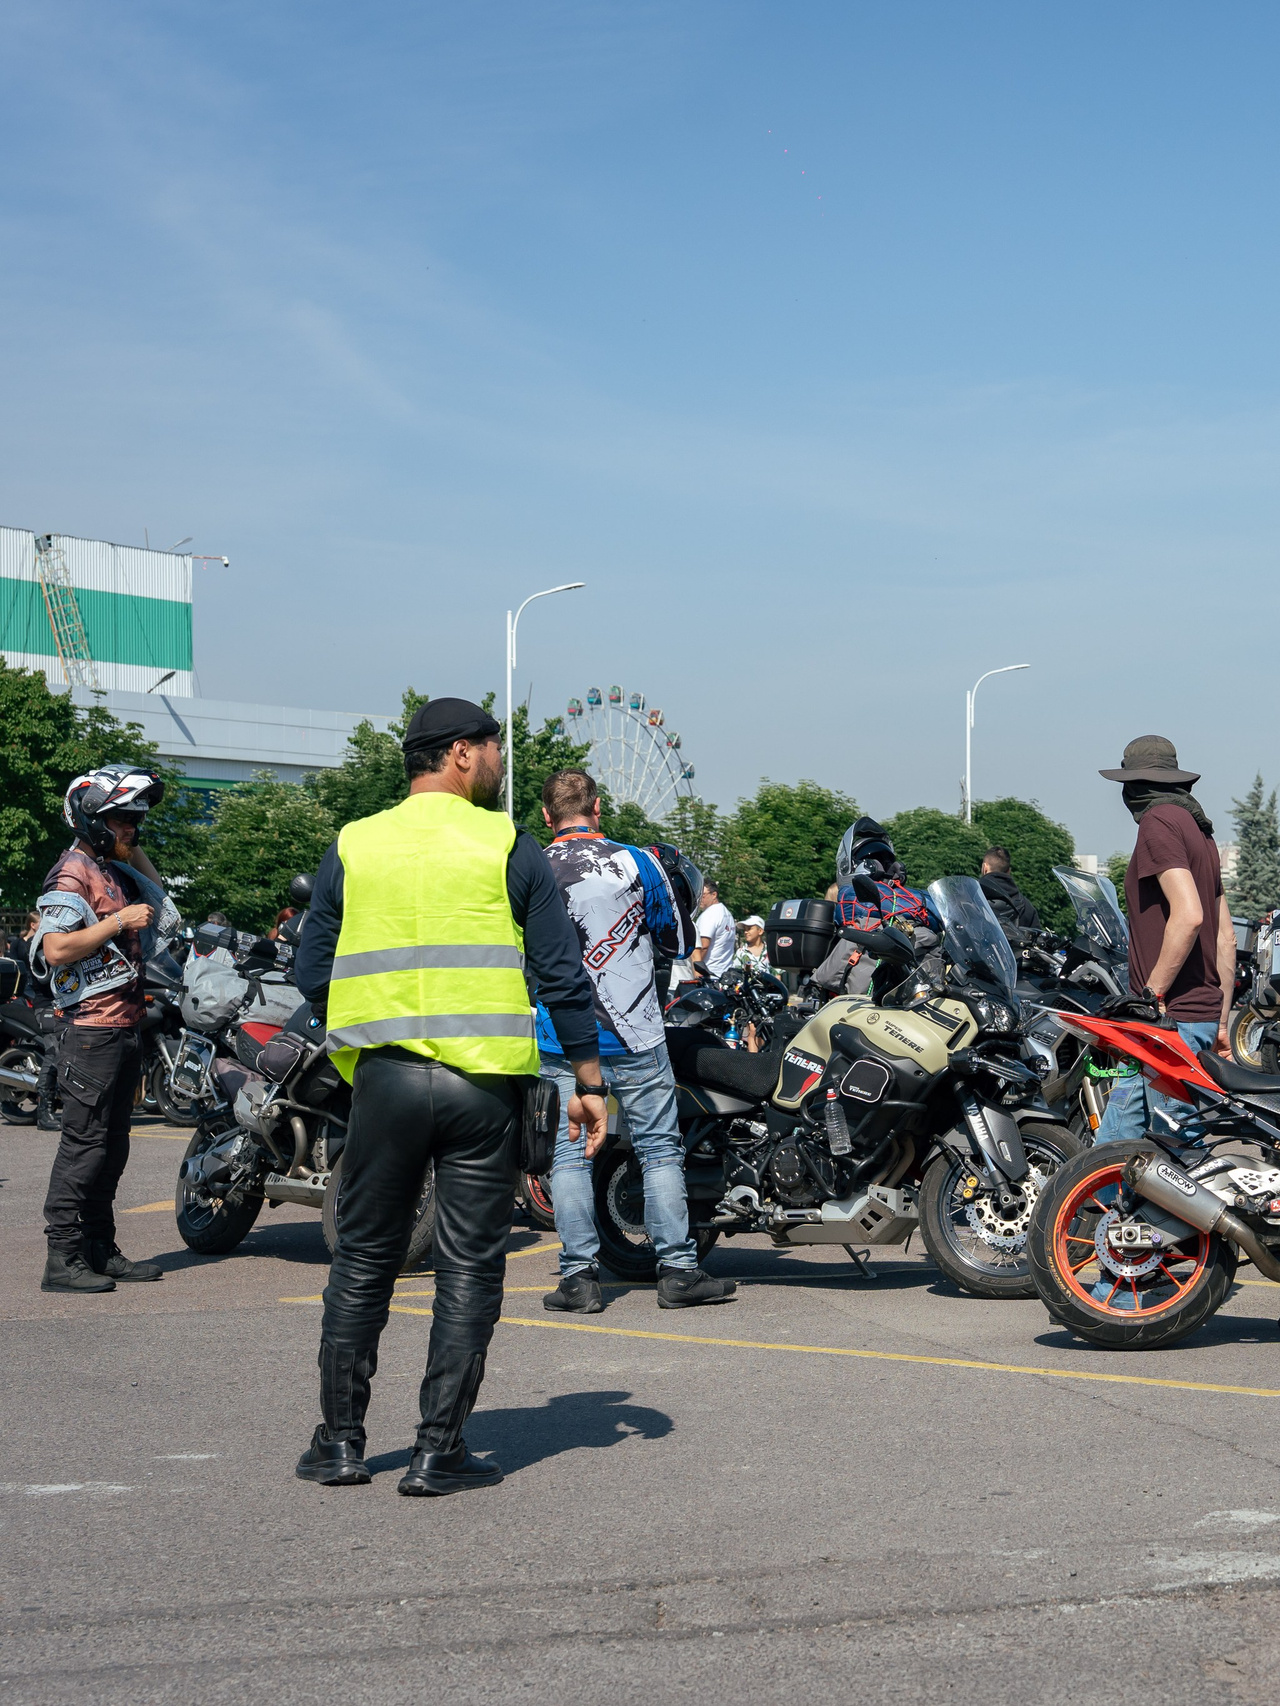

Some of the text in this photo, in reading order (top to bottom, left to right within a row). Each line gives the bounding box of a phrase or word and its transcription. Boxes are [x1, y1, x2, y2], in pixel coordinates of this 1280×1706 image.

[883, 1025, 925, 1054] TENERE
[966, 1102, 989, 1141] YAMAHA
[1160, 1166, 1195, 1191] ARROW
